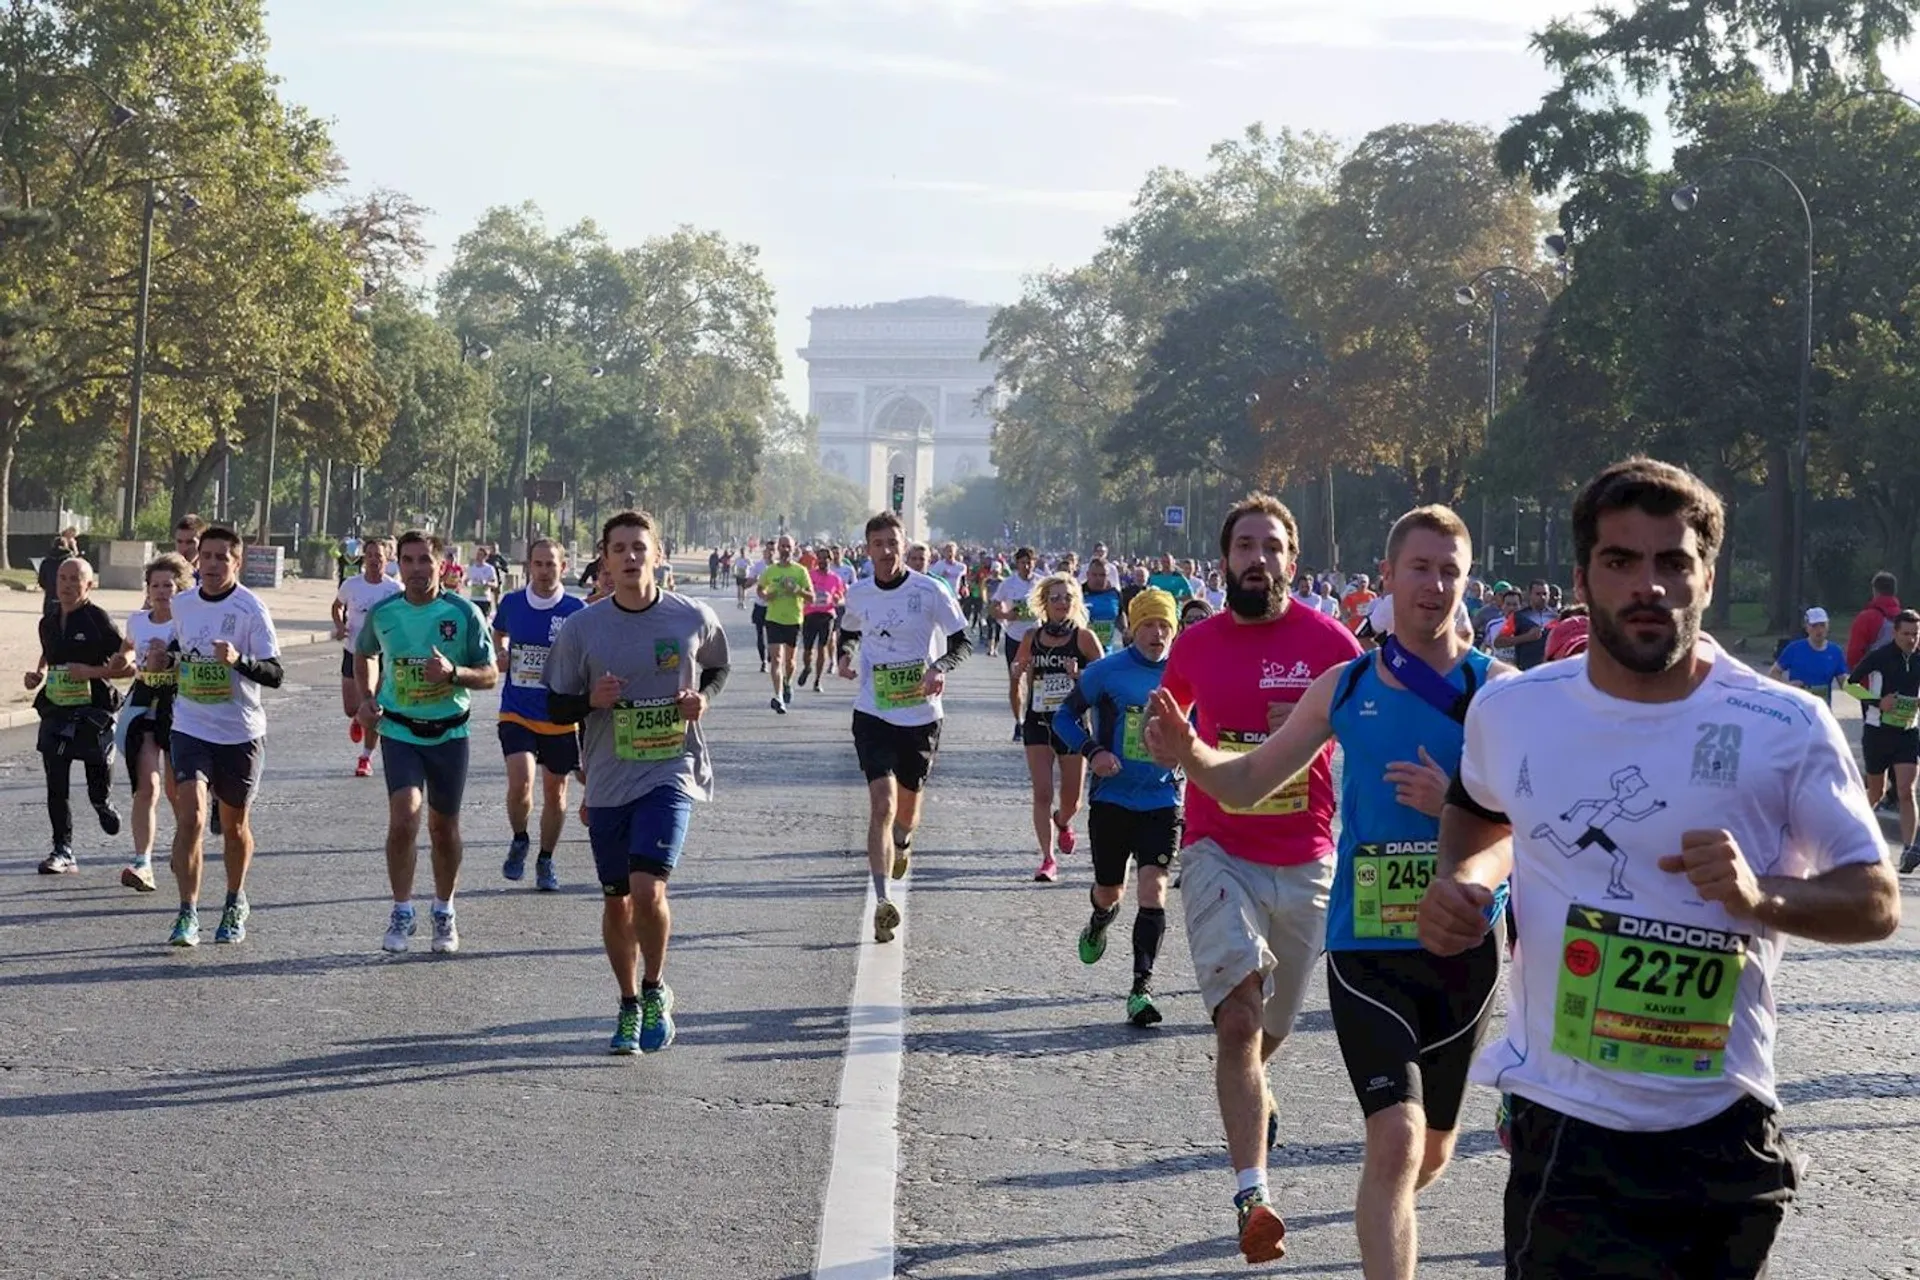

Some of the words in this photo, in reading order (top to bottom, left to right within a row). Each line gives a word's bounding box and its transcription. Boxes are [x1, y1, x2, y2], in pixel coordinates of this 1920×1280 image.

[192, 665, 226, 681] 14633
[889, 668, 921, 686] 9746
[635, 707, 681, 731] 25484
[1726, 696, 1793, 726] DIADORA
[1696, 722, 1742, 749] 20
[1617, 916, 1746, 952] DIADORA
[1614, 945, 1725, 1000] 2270
[1643, 1002, 1687, 1016] XAVIER
